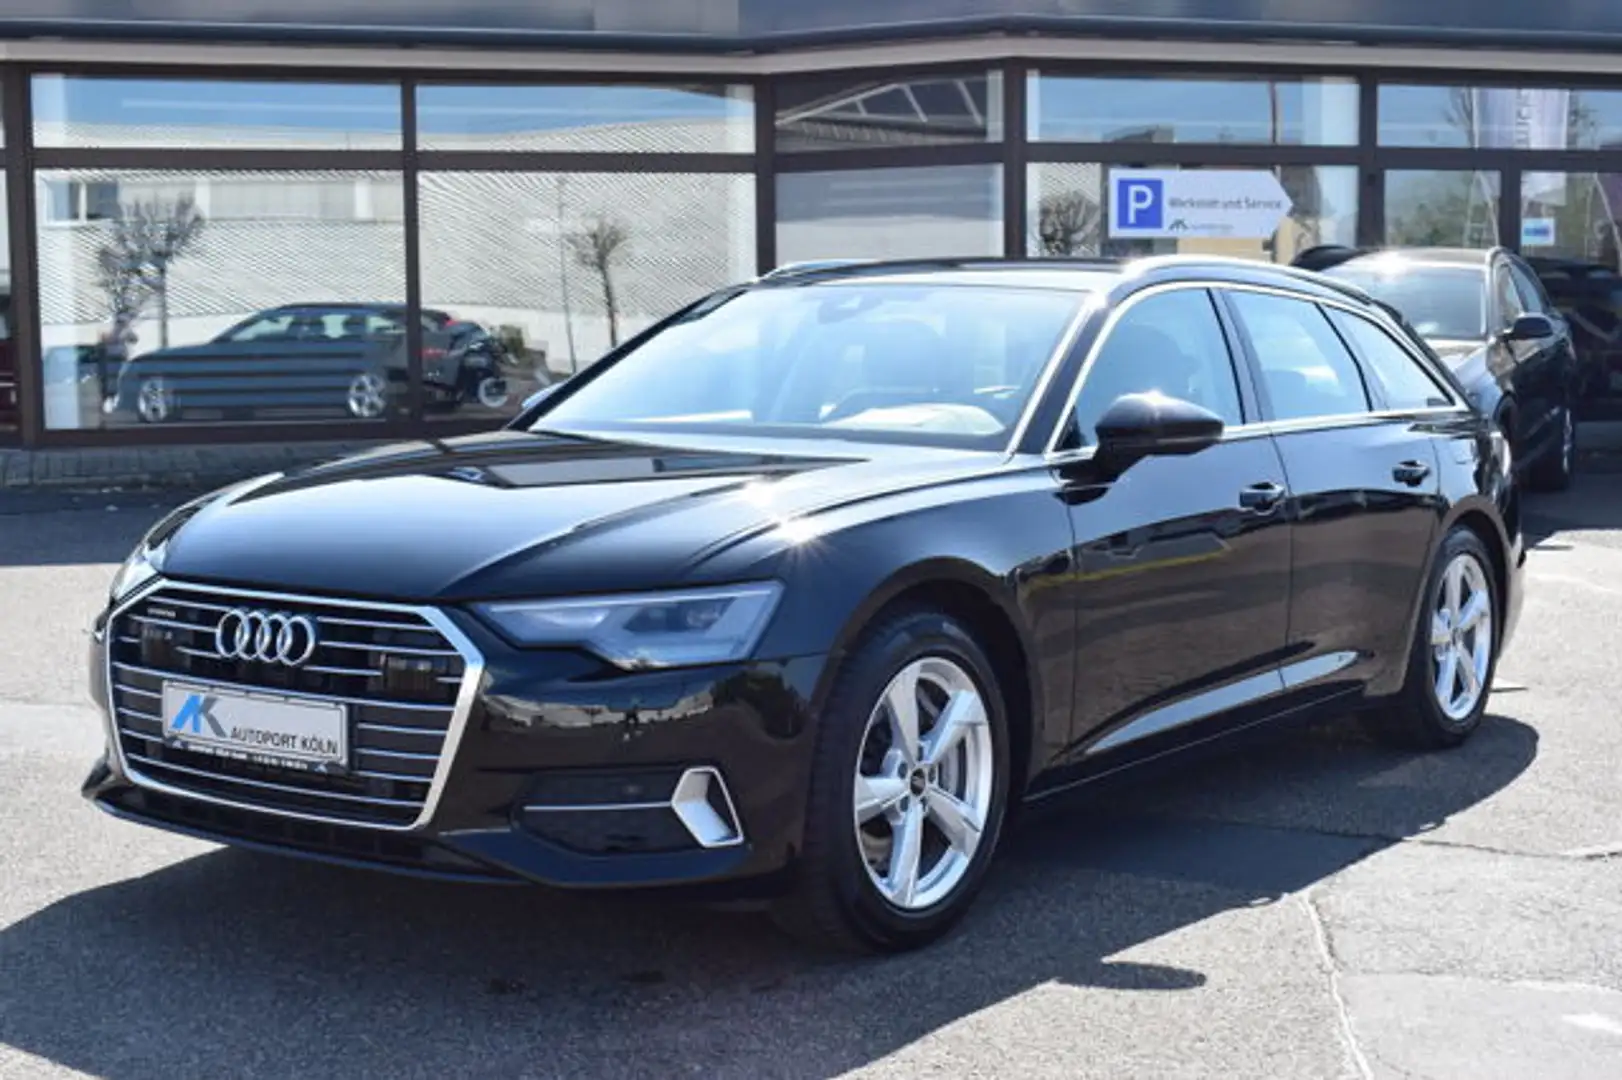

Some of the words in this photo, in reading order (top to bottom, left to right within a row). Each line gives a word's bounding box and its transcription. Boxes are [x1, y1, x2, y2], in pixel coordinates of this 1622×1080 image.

[1128, 185, 1153, 224] P
[1244, 196, 1282, 210] Service
[230, 726, 297, 750] AUTOPORT
[301, 734, 338, 755] KÖLN
